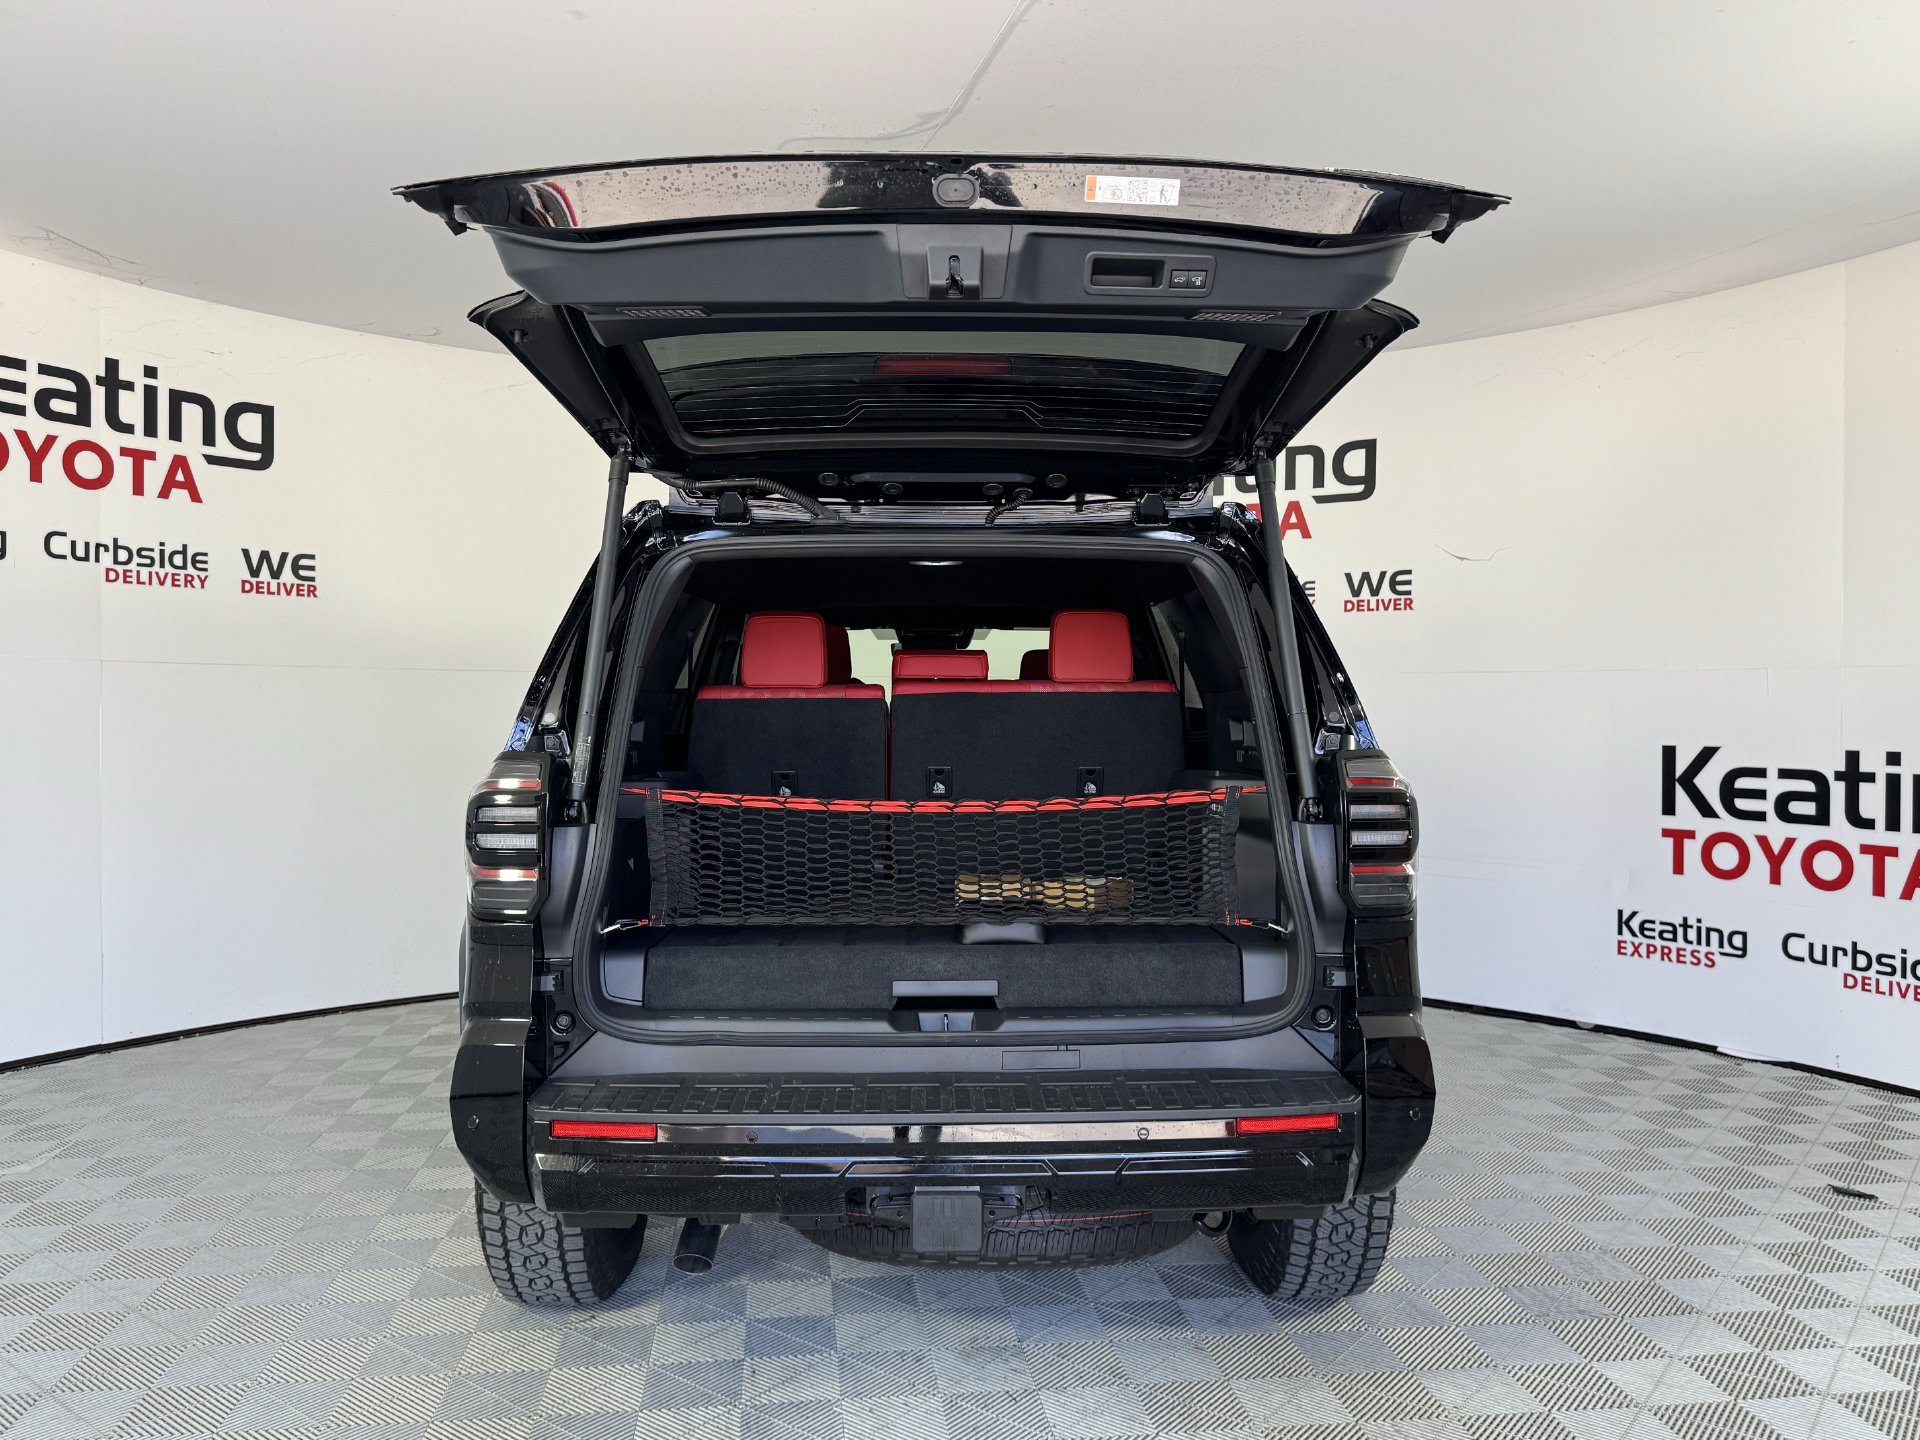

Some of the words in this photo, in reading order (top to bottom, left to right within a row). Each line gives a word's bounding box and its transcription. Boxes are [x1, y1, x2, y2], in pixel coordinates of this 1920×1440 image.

[0, 427, 203, 504] YOTA
[44, 531, 209, 572] Curbside
[105, 568, 209, 590] DELIVERY
[241, 579, 318, 598] DELIVER
[1343, 597, 1414, 613] DELIVER
[1617, 909, 1748, 959] Keating
[1616, 940, 1716, 969] EXPRESS
[918, 1216, 977, 1232] TOYOTA
